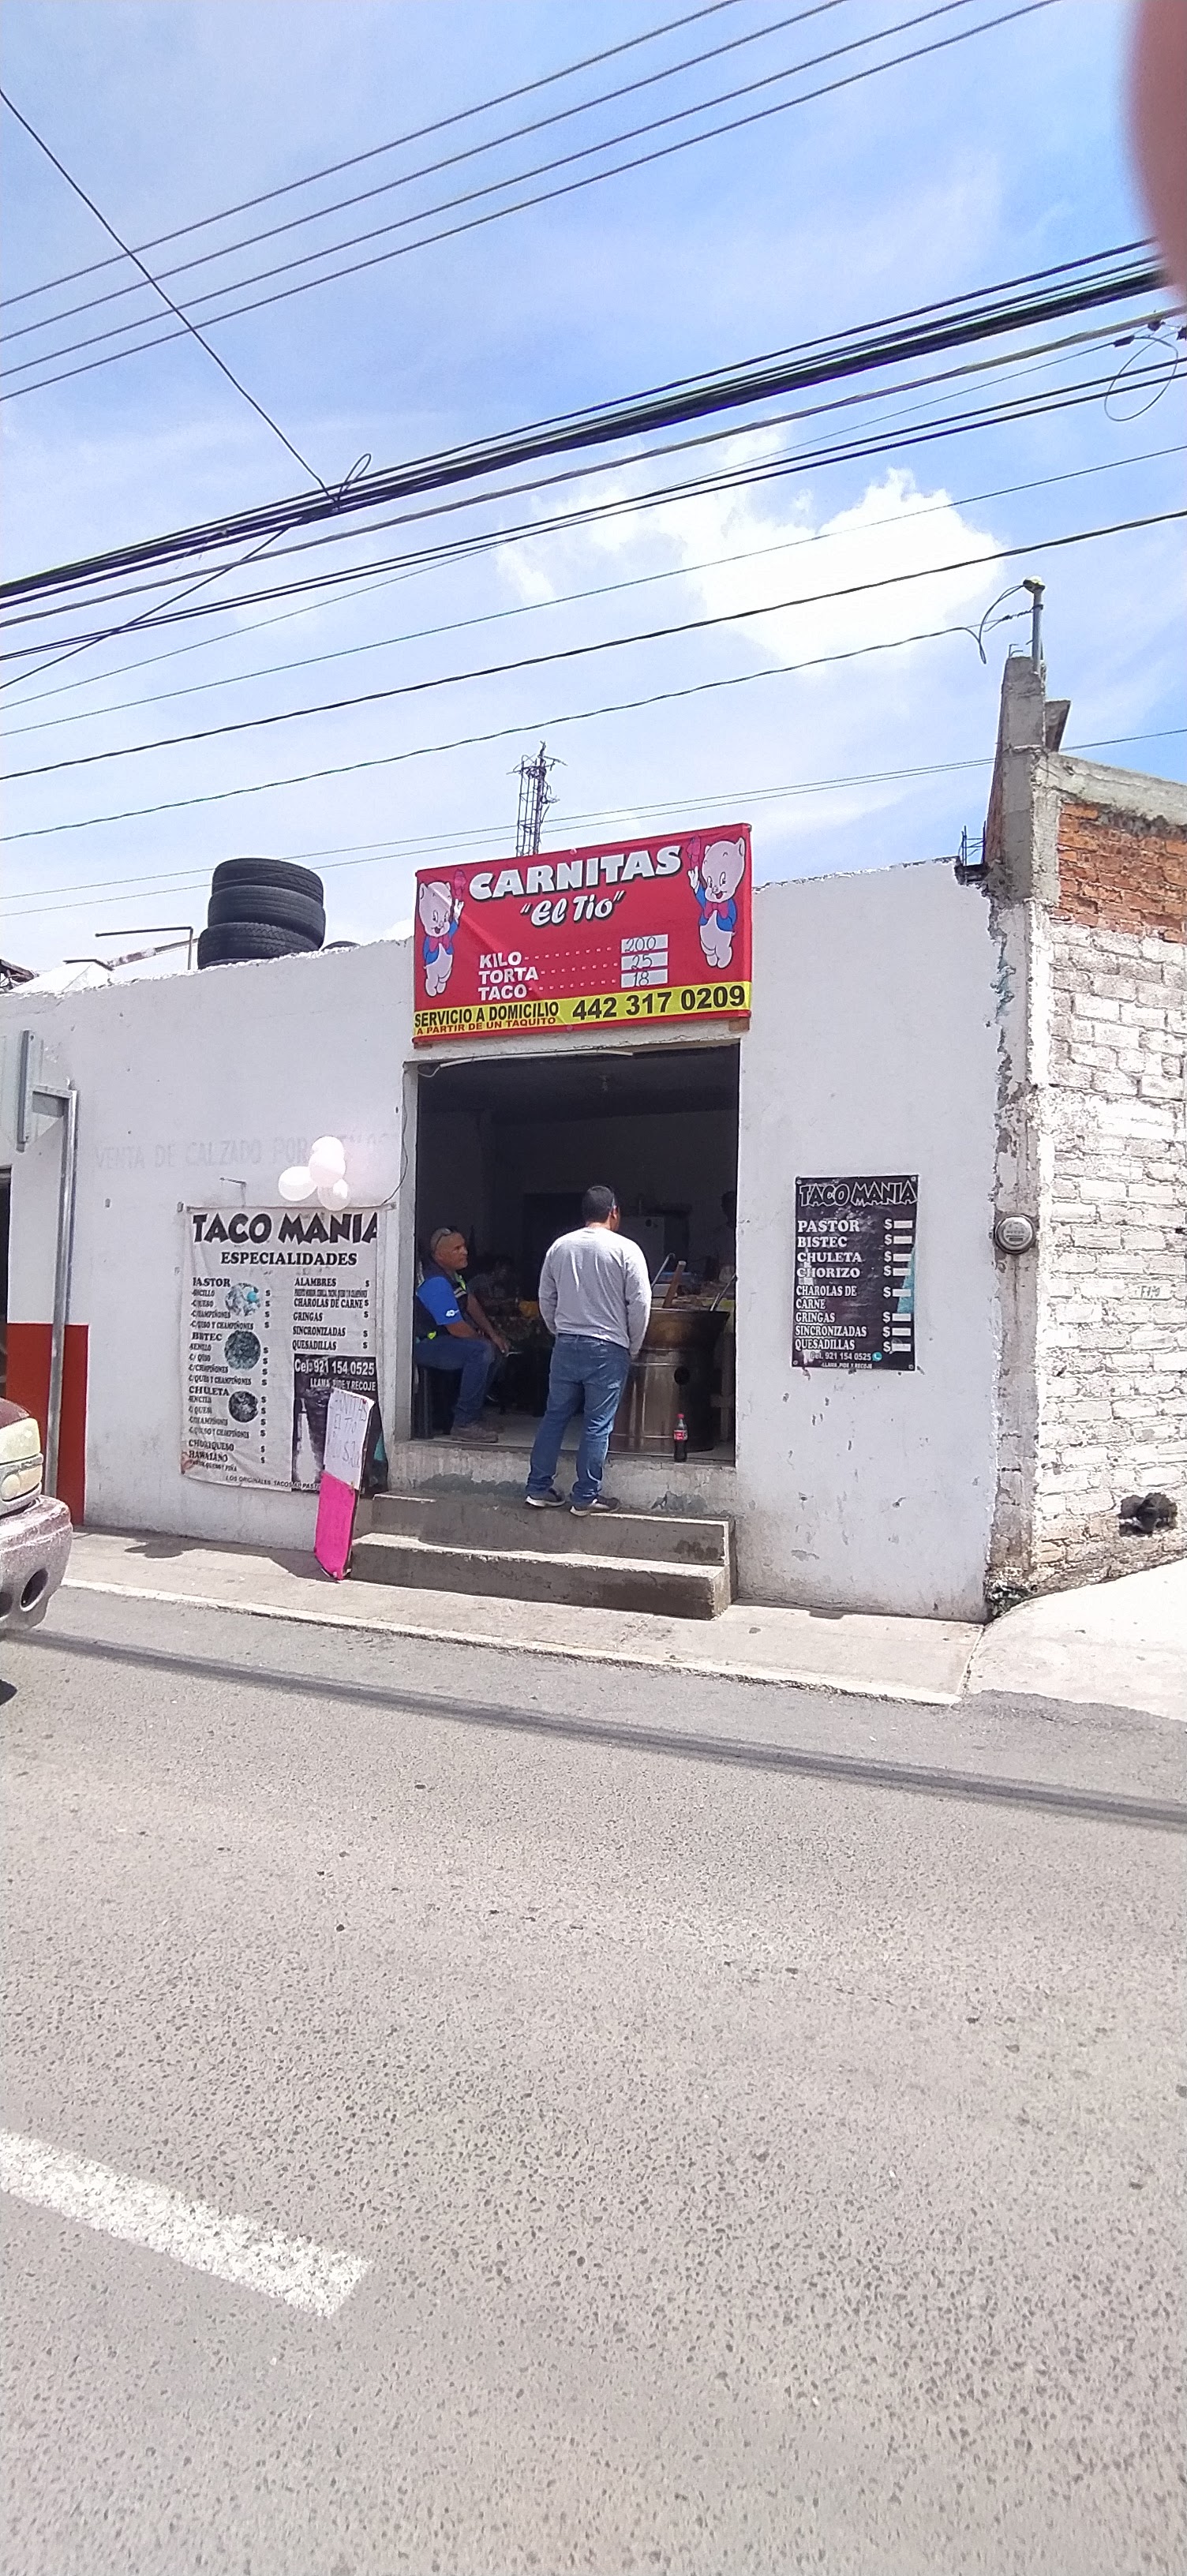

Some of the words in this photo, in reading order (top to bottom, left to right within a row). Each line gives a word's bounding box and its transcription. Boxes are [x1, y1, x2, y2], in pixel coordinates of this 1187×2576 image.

[469, 845, 681, 900] CARNITAS
[479, 952, 521, 968] KILO
[626, 935, 656, 951] 200
[478, 967, 538, 984] TORTA
[631, 953, 653, 969] 25
[477, 986, 528, 1001] TACO
[631, 971, 650, 987] 18
[414, 1008, 472, 1028] SERVICIO
[476, 1007, 485, 1023] A
[489, 1002, 559, 1020] DOMICILIO
[572, 997, 617, 1020] 442
[625, 991, 672, 1016] 317
[680, 985, 745, 1010] 0209
[426, 1024, 465, 1034] PARTIR
[506, 1017, 556, 1028] TAQUITO
[799, 1183, 850, 1207] TACO
[851, 1180, 918, 1208] MANIA
[193, 1212, 272, 1244] TACO
[278, 1211, 377, 1245] MANIA
[797, 1220, 860, 1233] PASTOR
[884, 1219, 893, 1230] $
[797, 1236, 848, 1249] BISTEC
[884, 1234, 893, 1245] $
[221, 1252, 358, 1266] ESPECIALIDADES
[797, 1252, 863, 1264] CHULETA
[884, 1251, 892, 1262] $
[796, 1267, 861, 1279] CHORIZO
[883, 1265, 892, 1277] $
[294, 1277, 336, 1286] ALAMBRES
[796, 1285, 844, 1297] CHAROLAS
[844, 1285, 857, 1297] DE
[883, 1286, 891, 1298] $
[294, 1297, 329, 1308] CHAROLAS
[330, 1299, 339, 1309] DE
[341, 1299, 363, 1309] CARNE
[796, 1298, 826, 1310] CARNE
[293, 1312, 323, 1322] GRINGAS
[796, 1312, 836, 1324] GRINGAS
[882, 1311, 891, 1323] $
[292, 1326, 346, 1337] SINCRONIZADAS
[795, 1326, 867, 1338] SINCRONIZADAS
[882, 1326, 891, 1338] $
[292, 1340, 337, 1351] QUESADILLAS
[795, 1339, 856, 1351] QUESADILLAS
[883, 1342, 891, 1353] $
[313, 1359, 329, 1373] 921
[331, 1361, 348, 1375] 154
[350, 1361, 375, 1376] 0525
[351, 1380, 376, 1391] RECOJE
